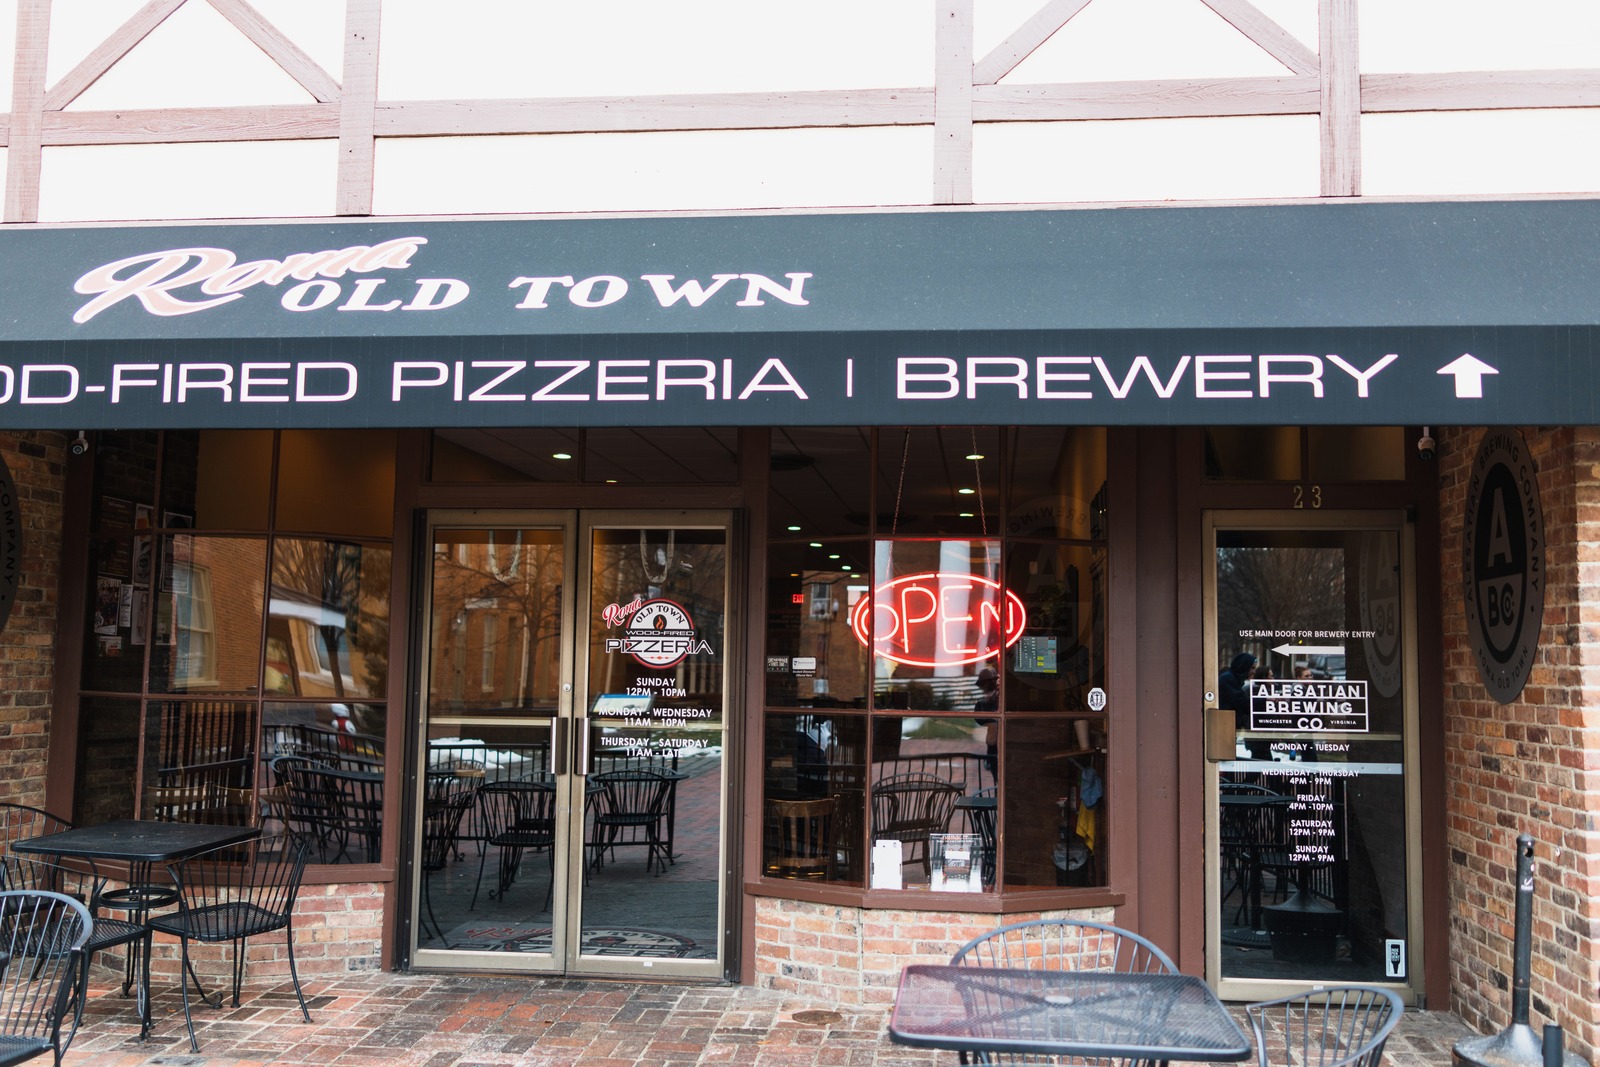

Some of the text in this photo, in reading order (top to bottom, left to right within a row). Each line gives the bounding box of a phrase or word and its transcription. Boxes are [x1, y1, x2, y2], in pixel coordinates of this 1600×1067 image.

[73, 237, 428, 324] Roma
[281, 272, 813, 311] OLD TOWN
[0, 362, 358, 404] D-FIRED
[392, 359, 809, 402] PIZZERIA
[897, 354, 1398, 399] BREWERY
[1293, 485, 1322, 509] 23
[1520, 465, 1539, 593] COMPANY
[602, 598, 641, 628] Roma
[635, 604, 686, 625] OLD TOWN
[861, 584, 1014, 654] OPEN
[1275, 630, 1296, 638] DOOR
[605, 638, 714, 655] PIZZERIA
[636, 677, 676, 687] SUNDAY
[626, 687, 651, 697] 12PM
[661, 687, 687, 697] 10PM
[1257, 684, 1360, 698] ALESATIAN
[598, 707, 643, 716] MONDAY
[653, 708, 713, 718] WEDNESDAY
[1266, 701, 1353, 714] BREWING
[624, 717, 652, 727] 11AM
[661, 718, 687, 727] 10PM
[1297, 717, 1327, 730] CO.
[601, 736, 709, 748] THURSDAY SATURDAY
[1270, 743, 1308, 751] MONDAY
[1315, 744, 1350, 752] TUESDAY
[626, 747, 653, 757] 11AM
[662, 749, 684, 758] LATE
[1262, 768, 1310, 776] WEDNESDAY
[1319, 769, 1359, 777] THURSDAY
[1290, 820, 1333, 828] SATURDAY
[1318, 829, 1335, 837] 9PM
[1295, 845, 1329, 853] SUNDAY
[1288, 854, 1310, 862] 12PM
[1318, 854, 1335, 862] 9PM
